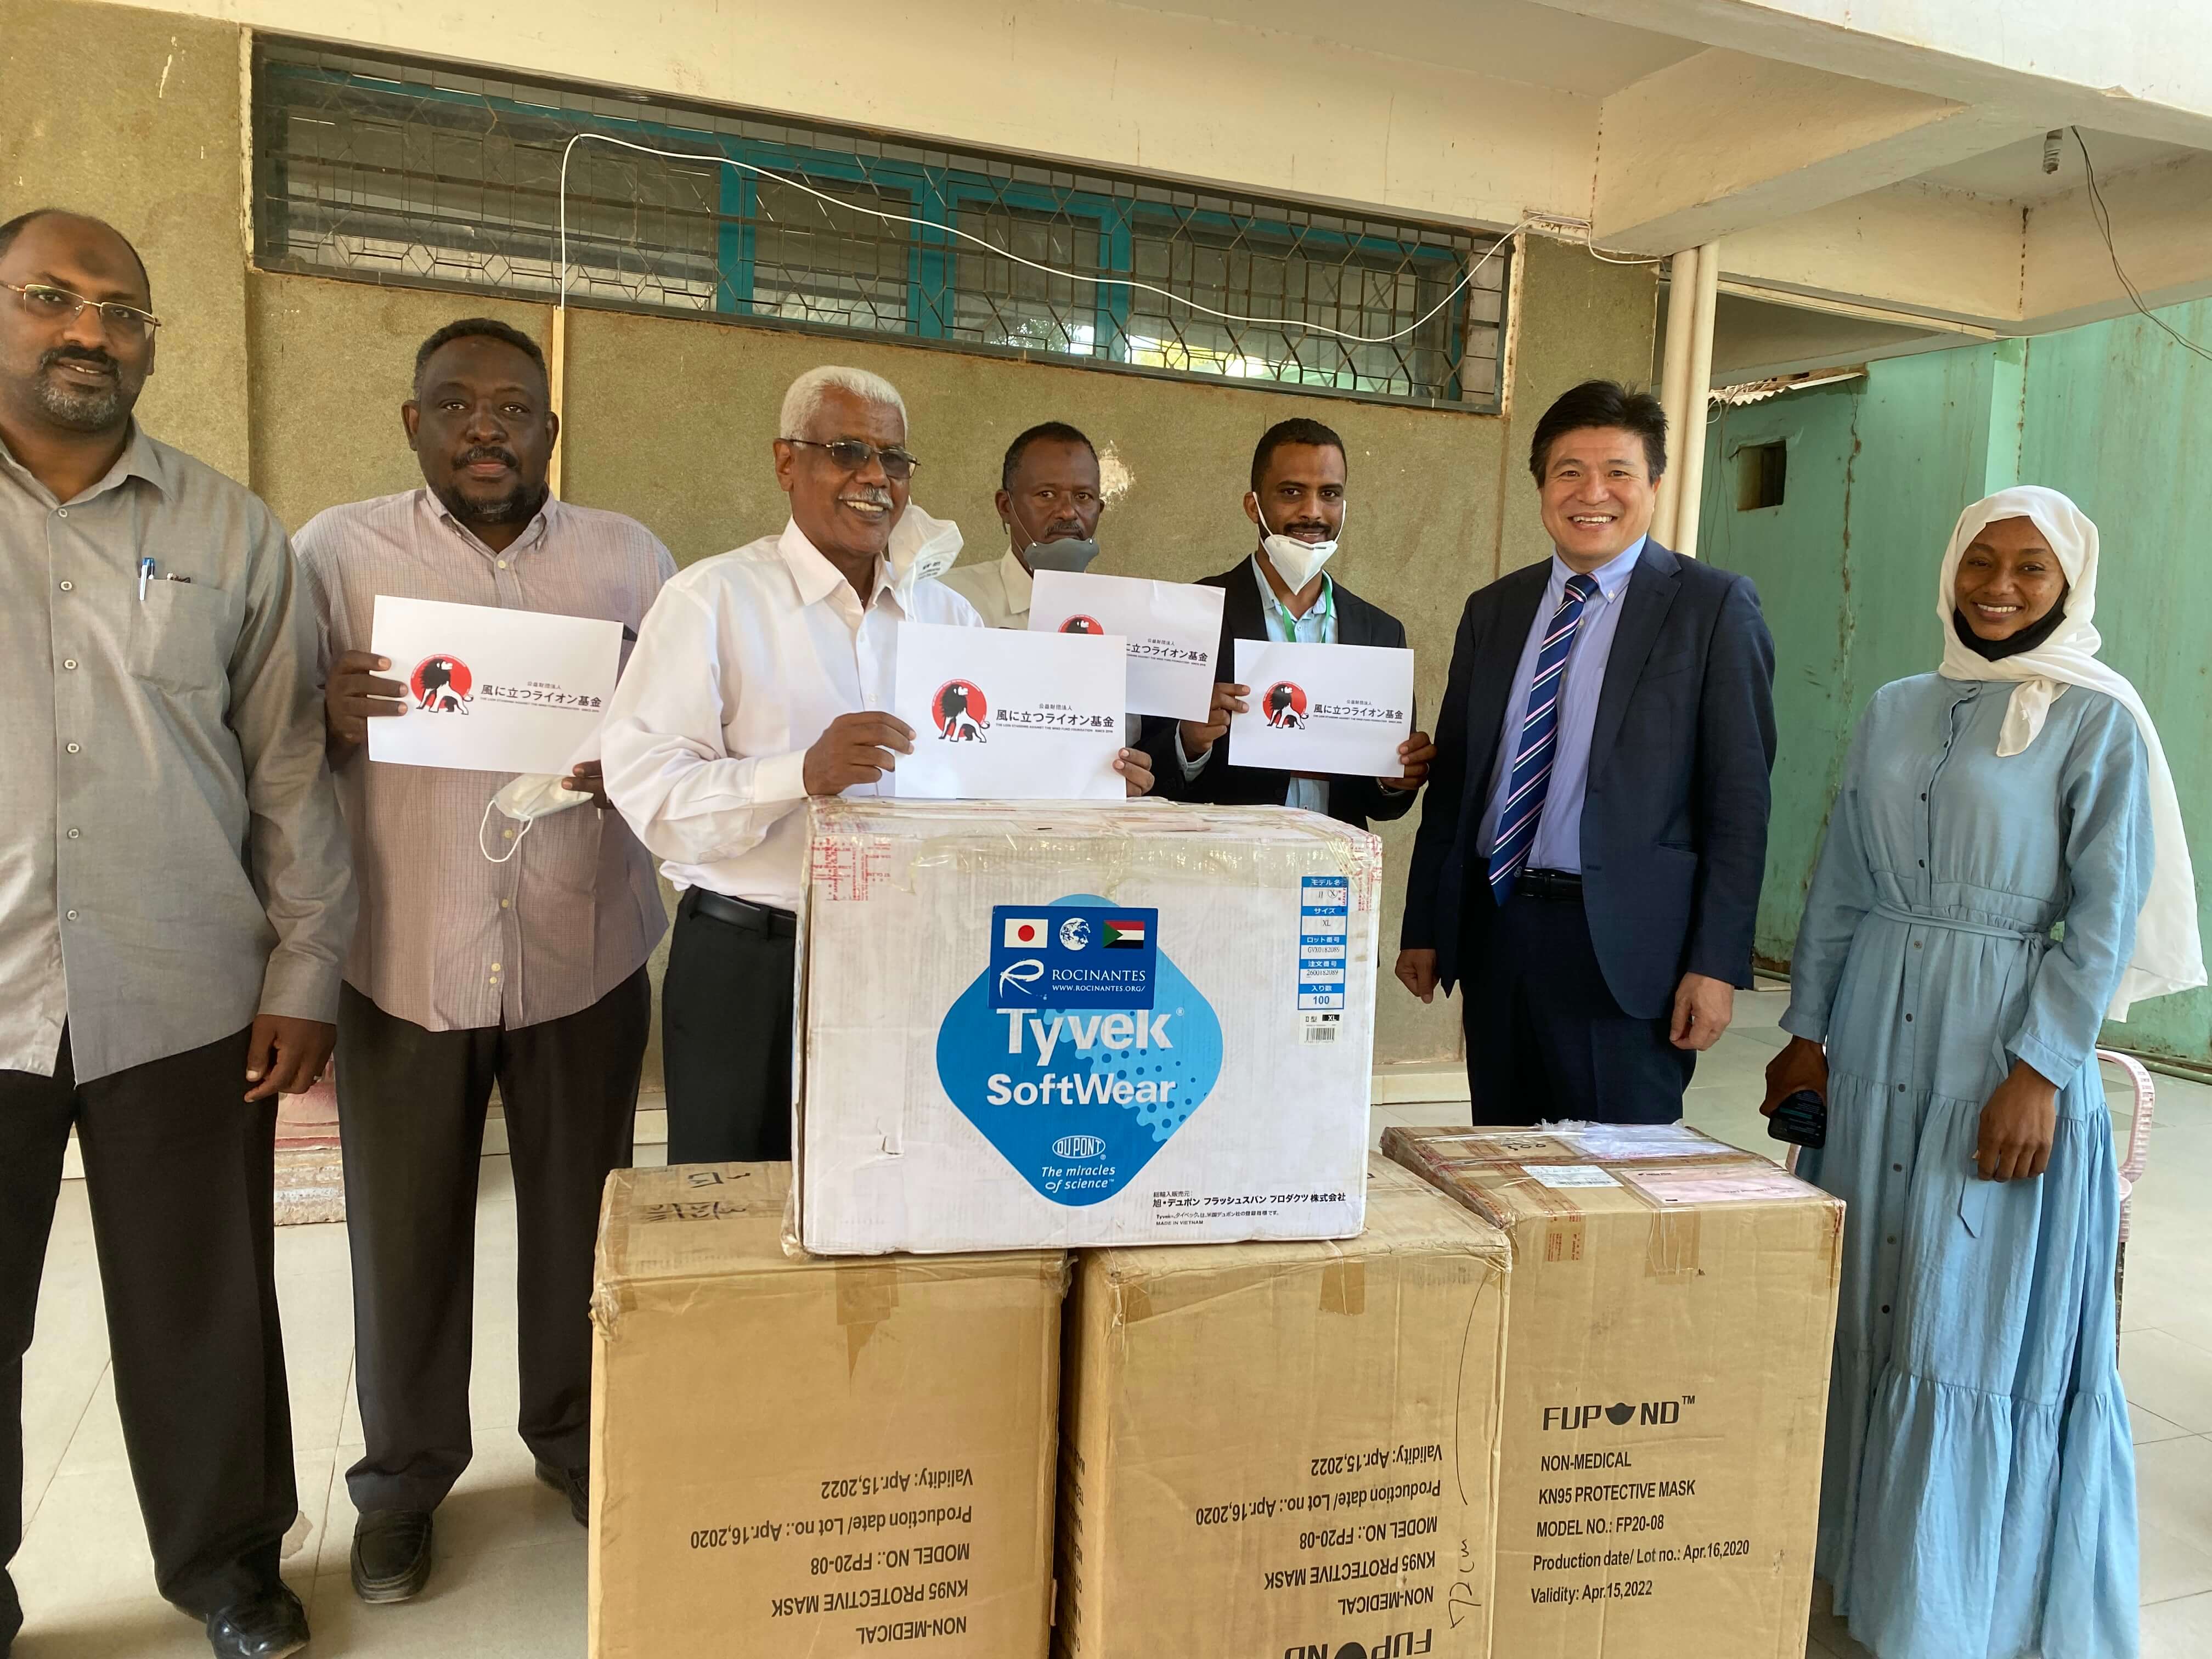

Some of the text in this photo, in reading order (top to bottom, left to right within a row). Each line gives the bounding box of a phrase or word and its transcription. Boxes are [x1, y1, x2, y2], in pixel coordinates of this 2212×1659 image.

[481, 684, 602, 708] 風に立つライオン基金
[996, 709, 1114, 727] 風に立つライオン基金
[1313, 704, 1403, 719] 風に立つライオン基金
[1052, 969, 1146, 982] ROCINANTES
[1313, 996, 1330, 1005] 100
[986, 1073, 1176, 1106] SoftWear
[1042, 1165, 1116, 1178] The miracles
[1045, 1180, 1063, 1194] of
[1310, 1193, 1346, 1203] 株式会社
[1311, 1448, 1390, 1476] Apr.15,2022
[1541, 1452, 1632, 1471] NON-MEDICAL
[822, 1471, 910, 1499] Apr.15,2022
[1370, 1480, 1440, 1504] Production
[1539, 1480, 1695, 1504] KN95 PROTECTIVE MASK
[1196, 1497, 1276, 1525] Apr.16,2020
[1308, 1494, 1329, 1511] Lot
[819, 1518, 843, 1536] Lot
[890, 1505, 972, 1528] Production
[1390, 1516, 1437, 1538] MODEL
[1537, 1520, 1583, 1537] MODEL
[1616, 1514, 1664, 1532] FP20-08
[691, 1520, 782, 1549] Apr.16,2020
[1300, 1527, 1353, 1549] FP20-08
[811, 1553, 872, 1575] FP20-08
[913, 1543, 969, 1565] MODEL
[1534, 1552, 1600, 1571] Production
[1637, 1548, 1656, 1564] Lot
[1683, 1540, 1749, 1563] Apr.16,2020
[1264, 1550, 1435, 1590] KN95 PROTECTIVE MASK
[771, 1579, 968, 1617] KN95 PROTECTIVE MASK
[1338, 1586, 1434, 1615] NON-MEDICAL
[1582, 1580, 1652, 1603] Apr.15,2022
[856, 1616, 966, 1644] NON-MEDICAL
